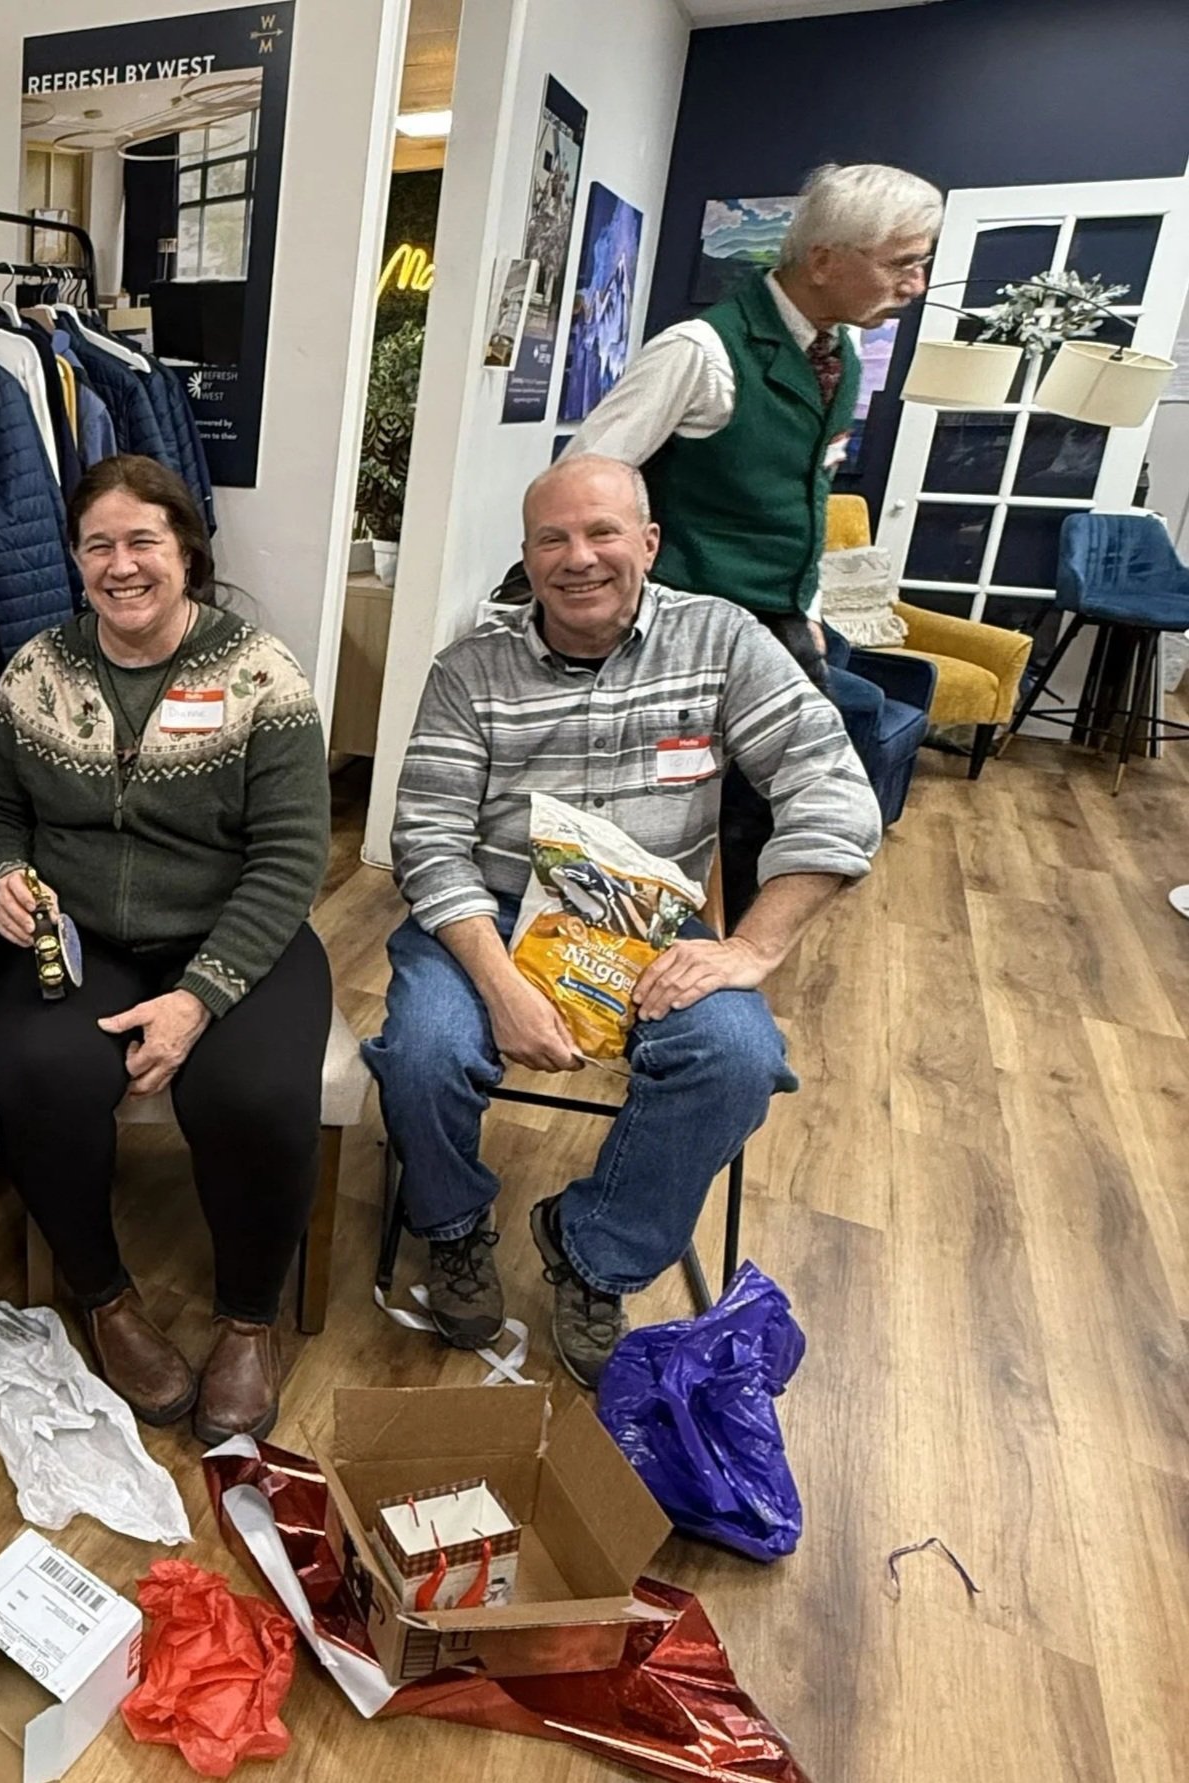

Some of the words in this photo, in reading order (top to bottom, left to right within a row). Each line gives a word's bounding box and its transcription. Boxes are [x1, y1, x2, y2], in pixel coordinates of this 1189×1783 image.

[261, 14, 276, 29] W
[258, 39, 273, 54] M
[28, 66, 119, 95] REFRESH
[125, 62, 152, 84] BY
[156, 55, 216, 79] WEST
[203, 371, 238, 381] REFRESH
[202, 381, 213, 390] BY
[202, 391, 224, 401] WEST
